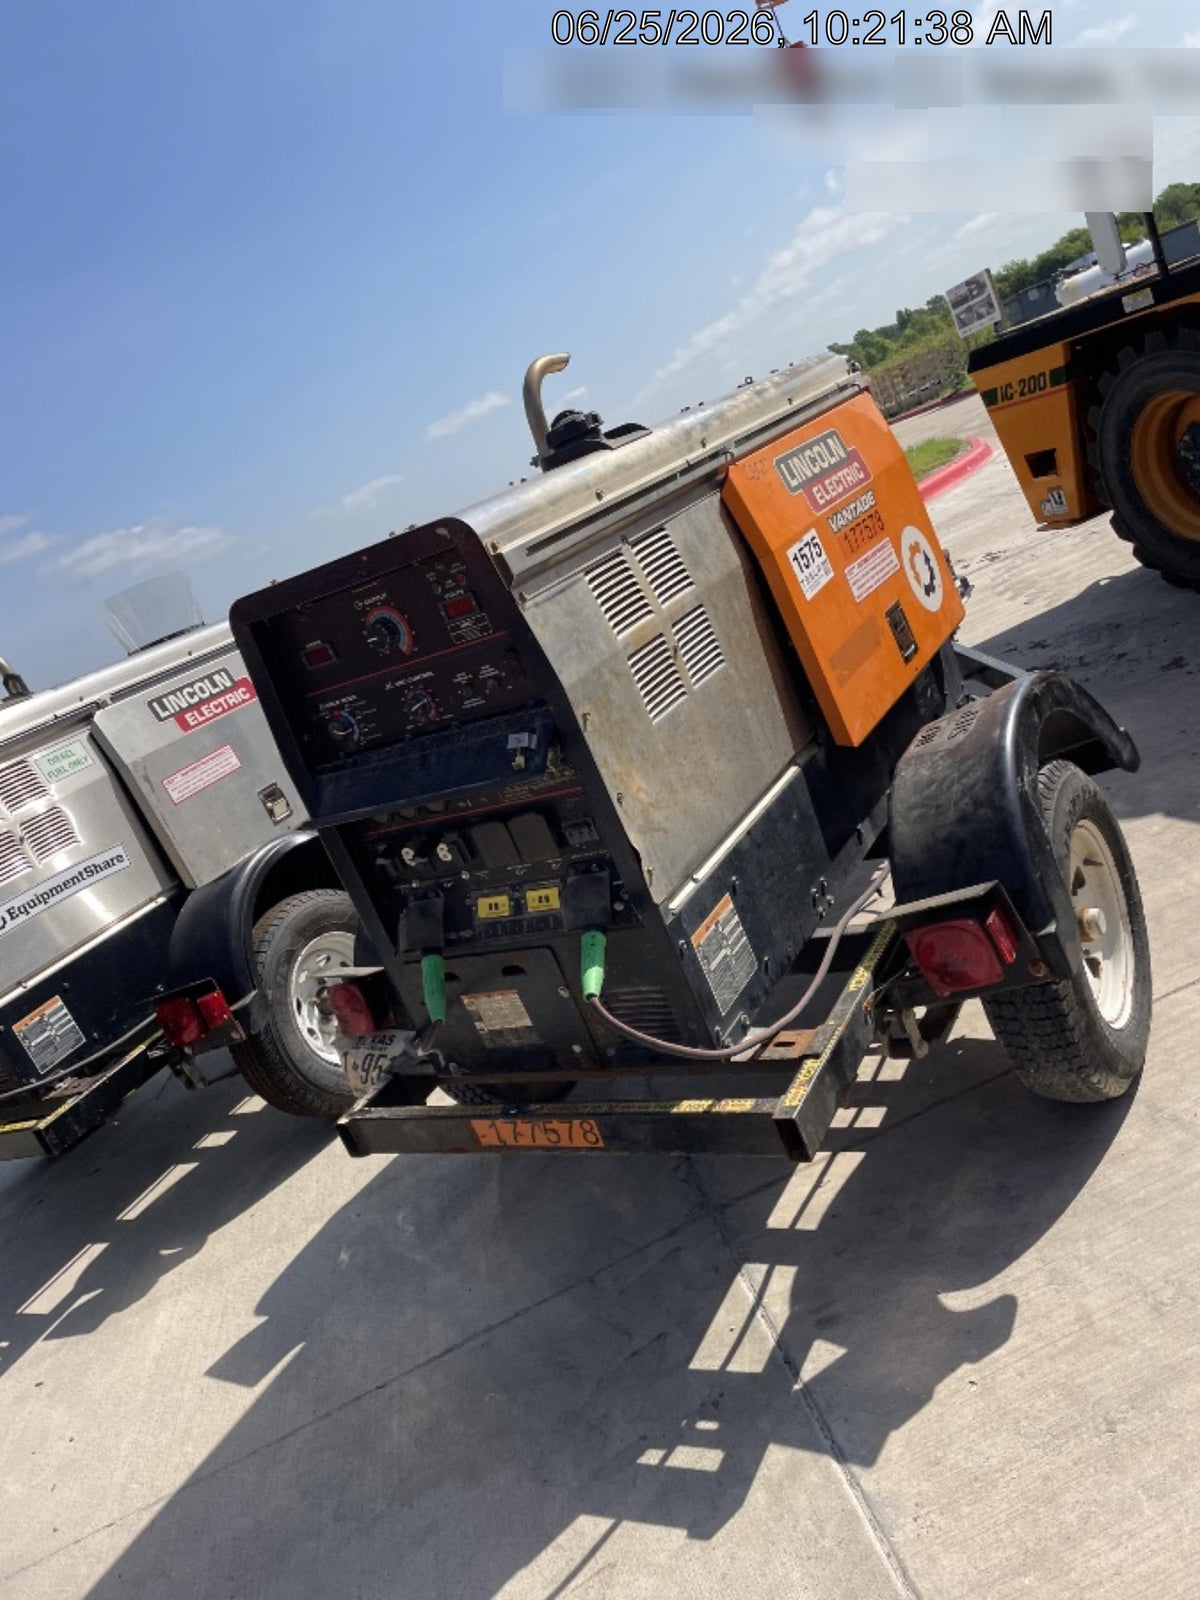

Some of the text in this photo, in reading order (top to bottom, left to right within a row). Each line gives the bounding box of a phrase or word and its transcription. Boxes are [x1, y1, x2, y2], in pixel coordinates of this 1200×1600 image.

[1000, 371, 1047, 402] IC-200
[780, 435, 848, 487] LINCOLN
[812, 461, 865, 506] ELECTRIC
[827, 489, 876, 533] VANTAGE
[792, 536, 823, 574] 1575
[152, 671, 234, 719] LINCOLN
[184, 686, 251, 727] ELECTRIC
[6, 852, 126, 921] EquipmentShare
